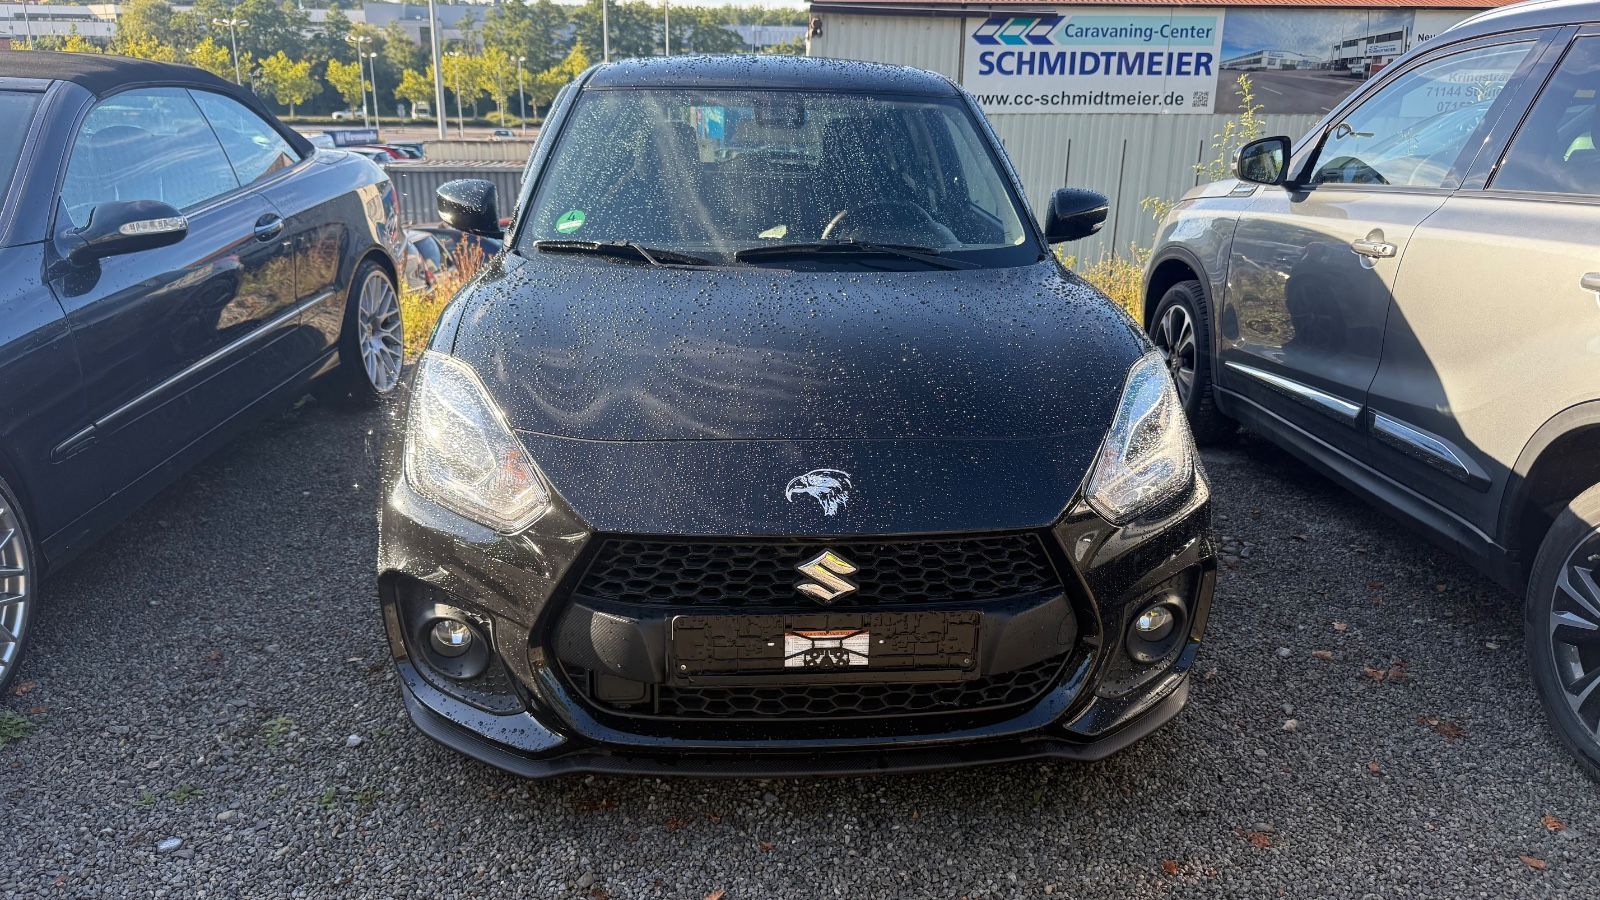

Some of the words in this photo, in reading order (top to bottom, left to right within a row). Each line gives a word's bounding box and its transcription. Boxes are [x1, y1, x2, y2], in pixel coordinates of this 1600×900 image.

[1064, 23, 1212, 42] Caravaning-Center
[978, 51, 1213, 76] SCHMIDTMEIER
[1426, 86, 1461, 97] 71144
